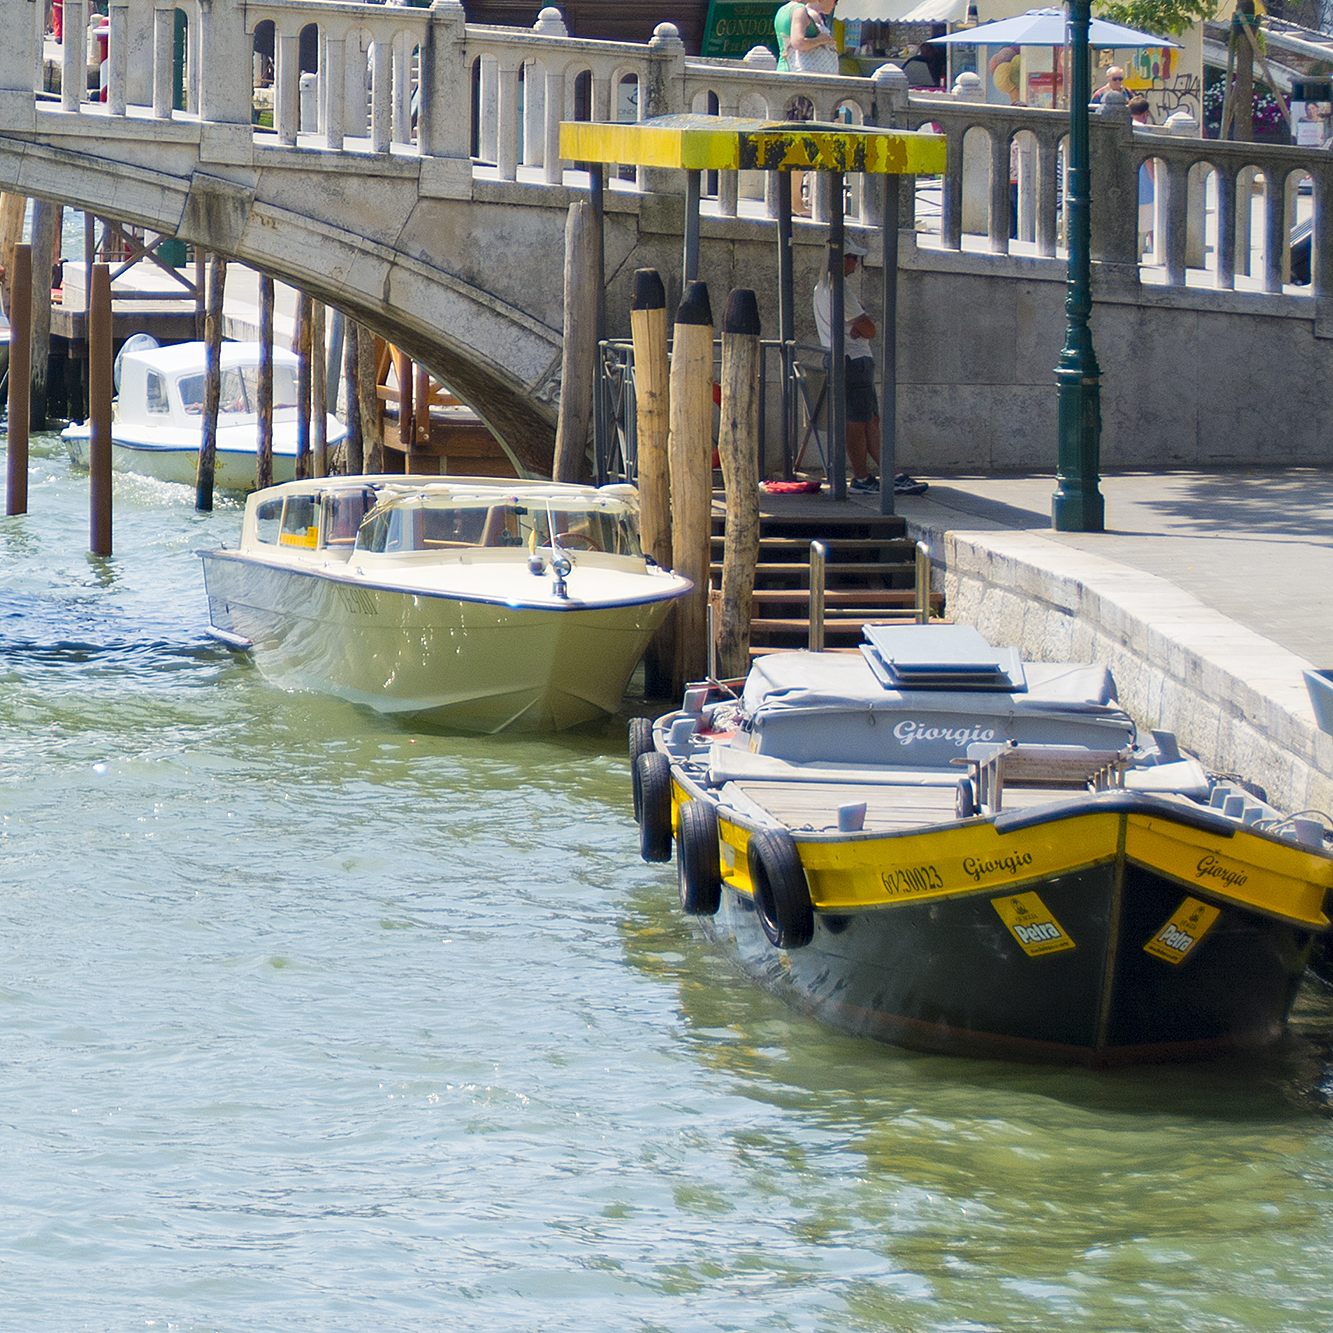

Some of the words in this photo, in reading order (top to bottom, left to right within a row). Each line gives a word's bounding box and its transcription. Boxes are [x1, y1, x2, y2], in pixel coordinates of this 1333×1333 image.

[716, 18, 776, 37] GONDOL
[893, 720, 995, 747] Giorgio
[962, 850, 1033, 882] Giorgio
[1195, 855, 1249, 888] Giorgio
[1013, 921, 1062, 945] Petra
[1157, 923, 1195, 953] Petra
